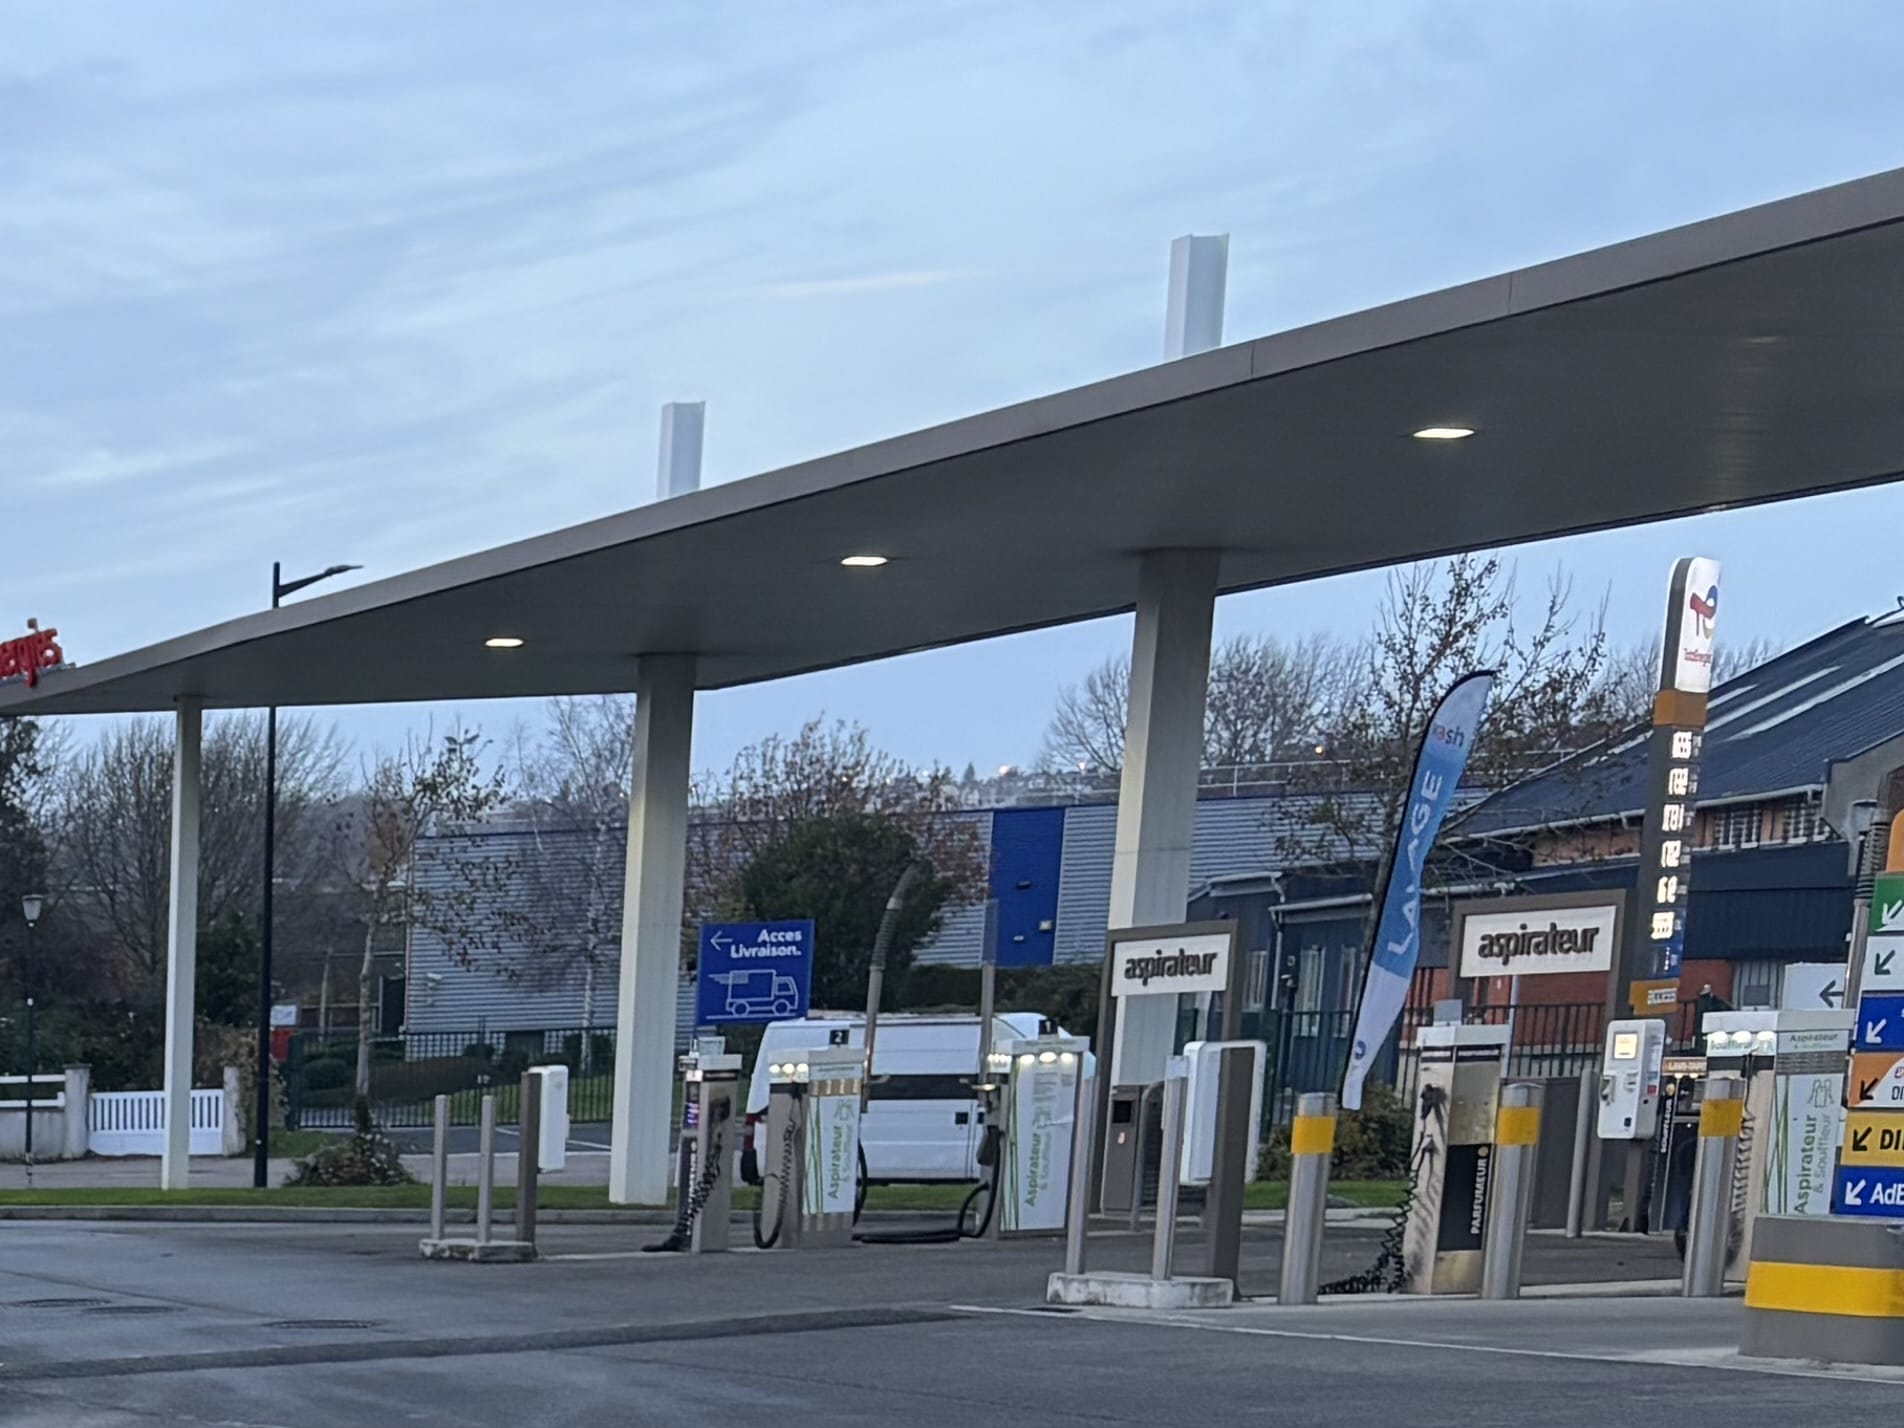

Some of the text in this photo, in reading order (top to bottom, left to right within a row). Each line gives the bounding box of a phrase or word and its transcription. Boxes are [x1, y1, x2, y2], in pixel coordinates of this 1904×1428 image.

[1478, 923, 1600, 966] aspirateur
[1124, 948, 1218, 986] aspirateur
[1879, 1128, 1904, 1151] DI
[1794, 1114, 1817, 1215] Aspirateur
